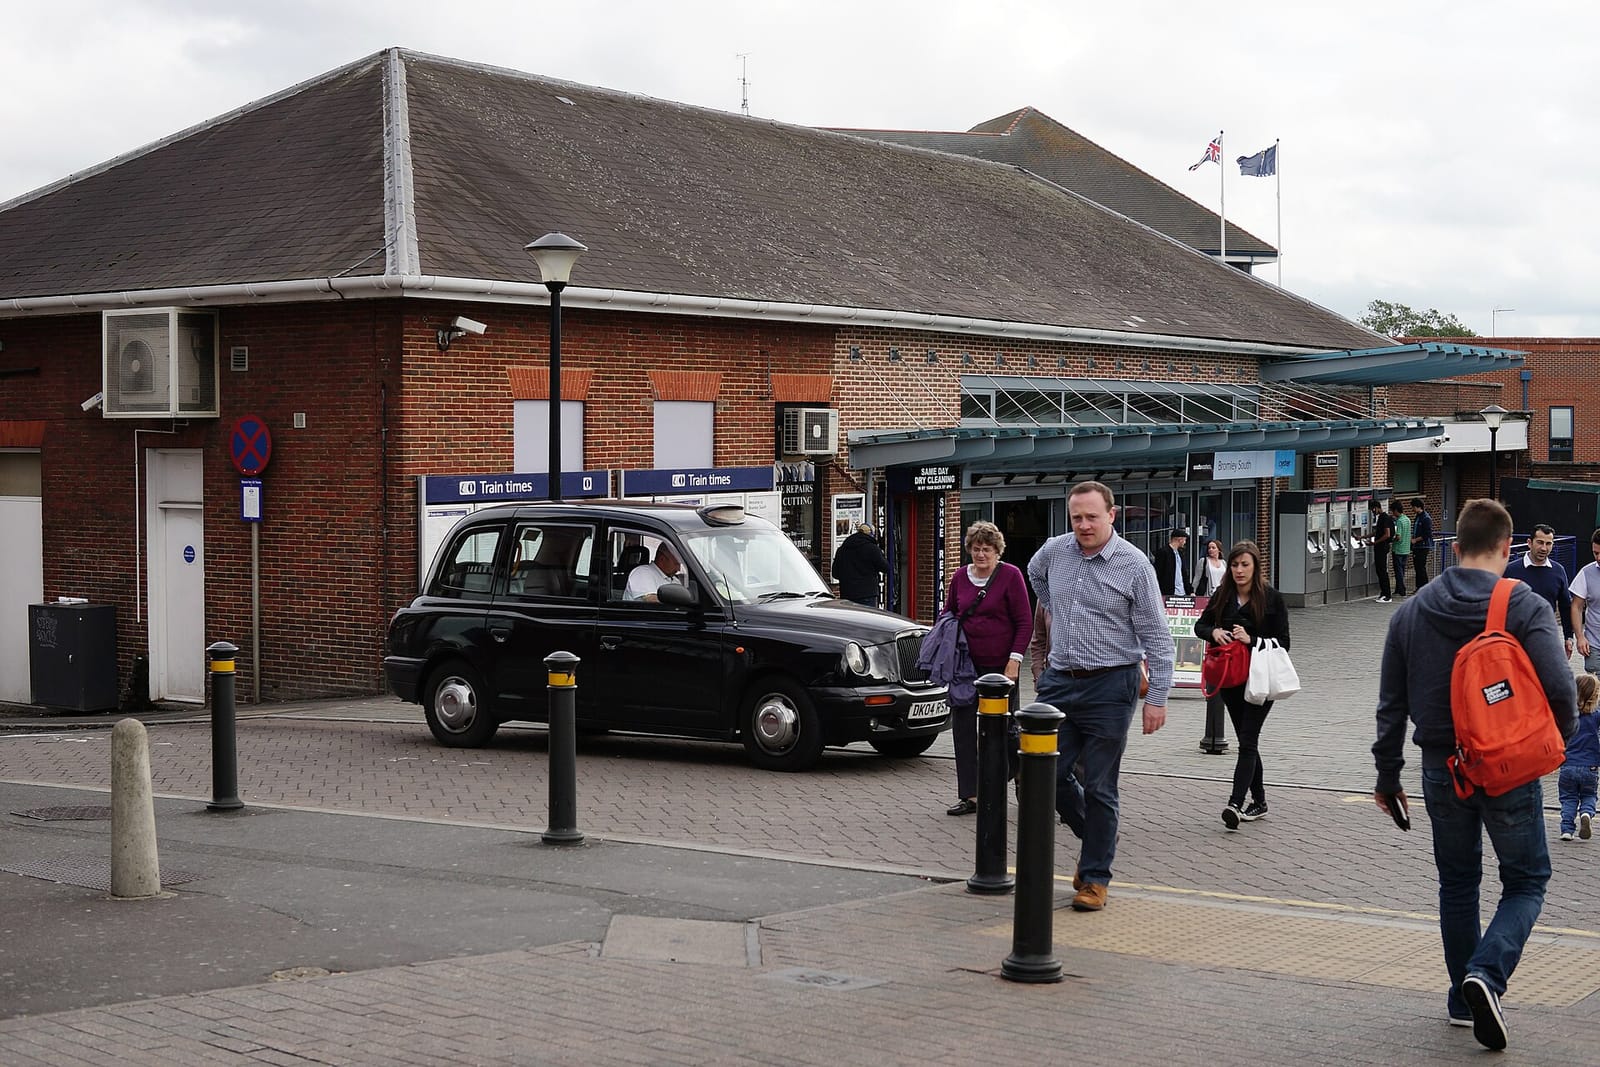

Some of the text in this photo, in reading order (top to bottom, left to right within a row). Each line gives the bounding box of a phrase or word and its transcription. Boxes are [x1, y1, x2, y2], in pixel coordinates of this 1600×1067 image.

[1217, 459, 1252, 472] Bromley South
[921, 467, 949, 476] SAME DAY
[688, 474, 731, 486] Train times
[914, 475, 955, 485] DRY CLEANING
[480, 480, 533, 494] Train times
[776, 484, 813, 493] OE REPAIRS
[782, 496, 812, 506] CUTTING
[1182, 608, 1203, 616] THE
[912, 703, 936, 717] DK04
